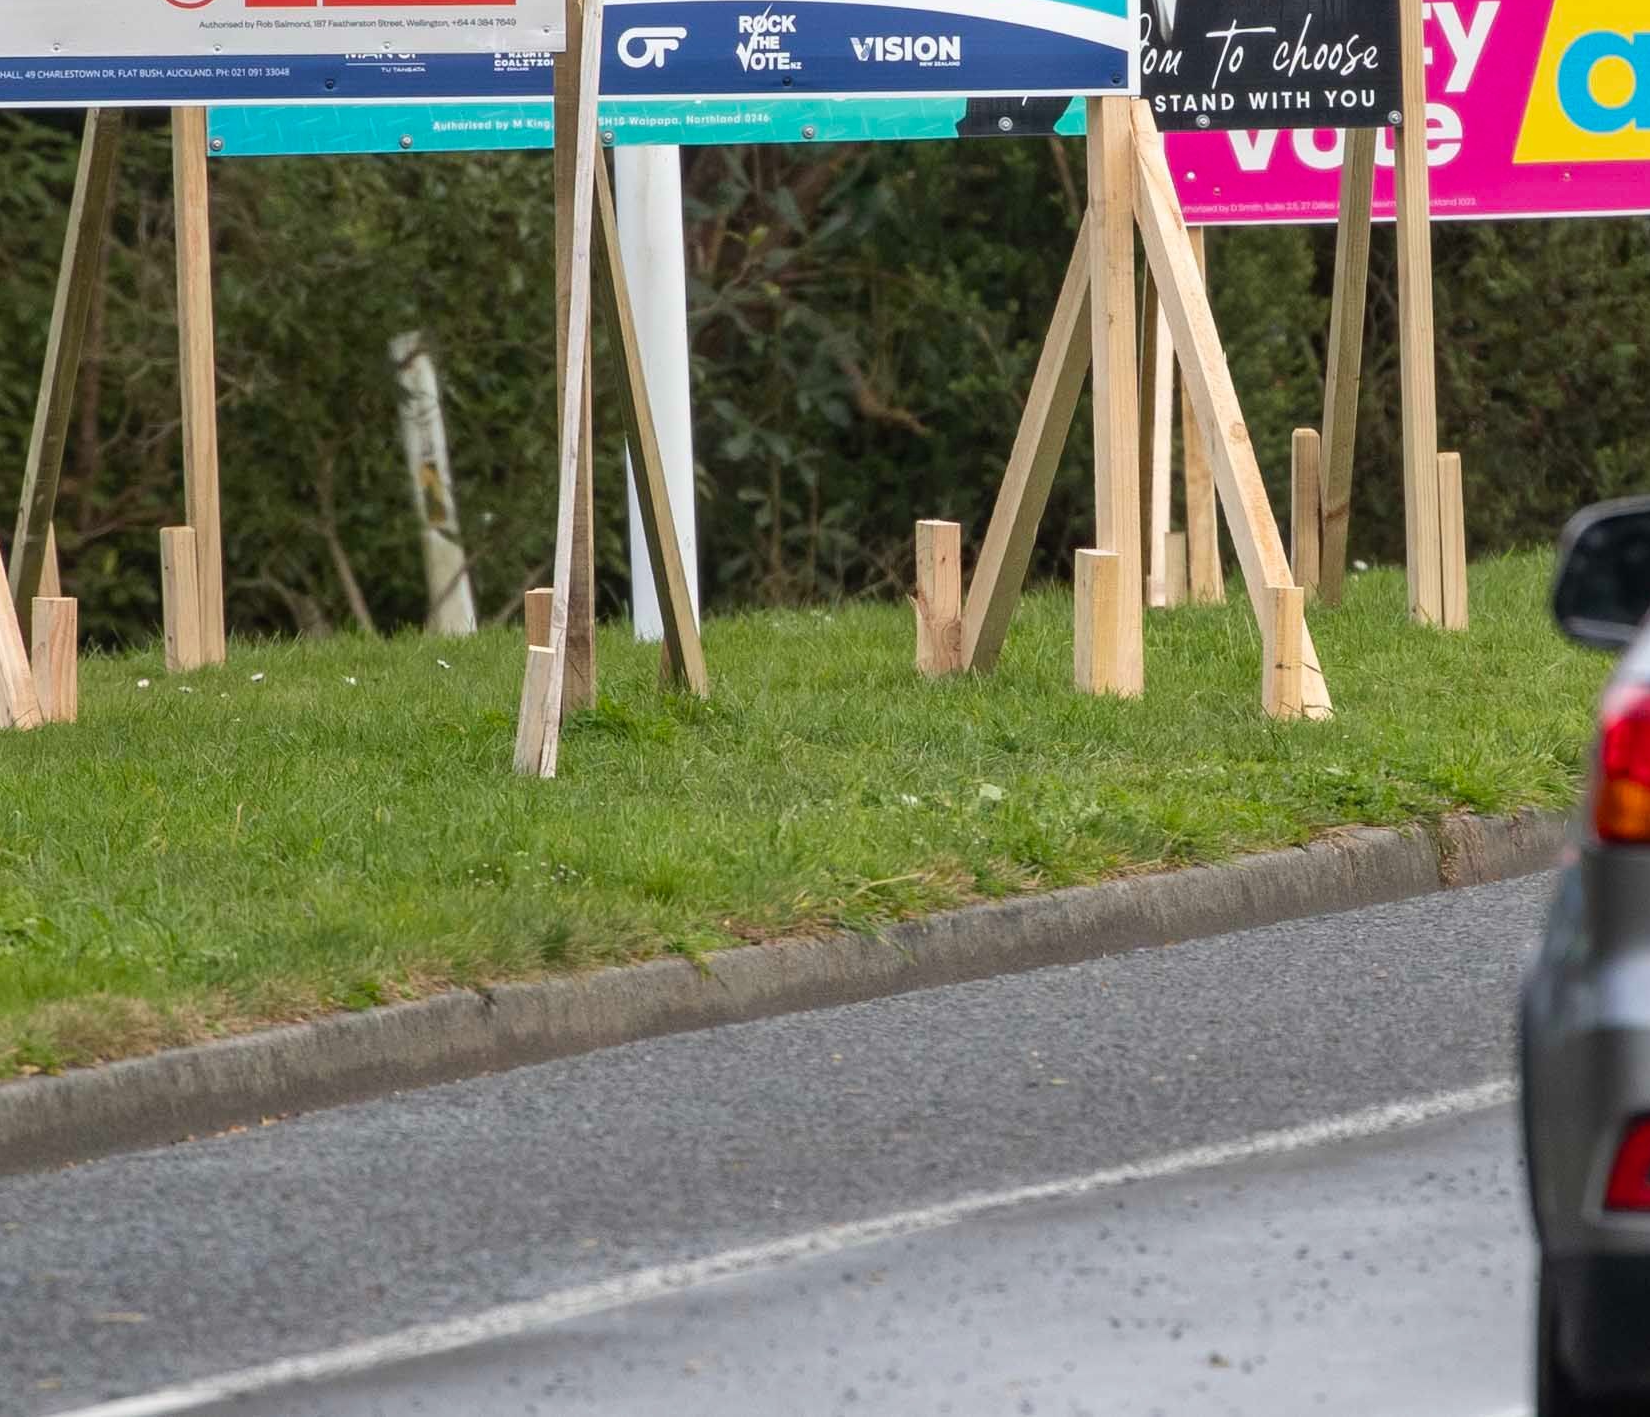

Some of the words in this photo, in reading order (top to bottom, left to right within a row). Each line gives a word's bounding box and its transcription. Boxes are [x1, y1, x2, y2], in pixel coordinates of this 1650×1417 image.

[199, 20, 243, 29] Authorised
[245, 21, 254, 30] by
[256, 20, 273, 28] Rob
[739, 14, 797, 34] ROCK
[751, 35, 780, 49] THE
[851, 36, 961, 61] VISION
[1206, 20, 1276, 89] to
[1273, 14, 1378, 76] choose
[25, 70, 36, 79] 49
[37, 69, 101, 79] CHARLESTOWN
[118, 69, 138, 78] FLAT
[231, 68, 246, 77] 021
[248, 67, 263, 77] 091
[1155, 94, 1234, 112] STAND
[1249, 92, 1309, 109] WITH
[1325, 90, 1374, 107] YOU
[433, 120, 492, 131] Authorised
[495, 120, 509, 131] by
[512, 118, 523, 129] M
[686, 113, 741, 125] Northland
